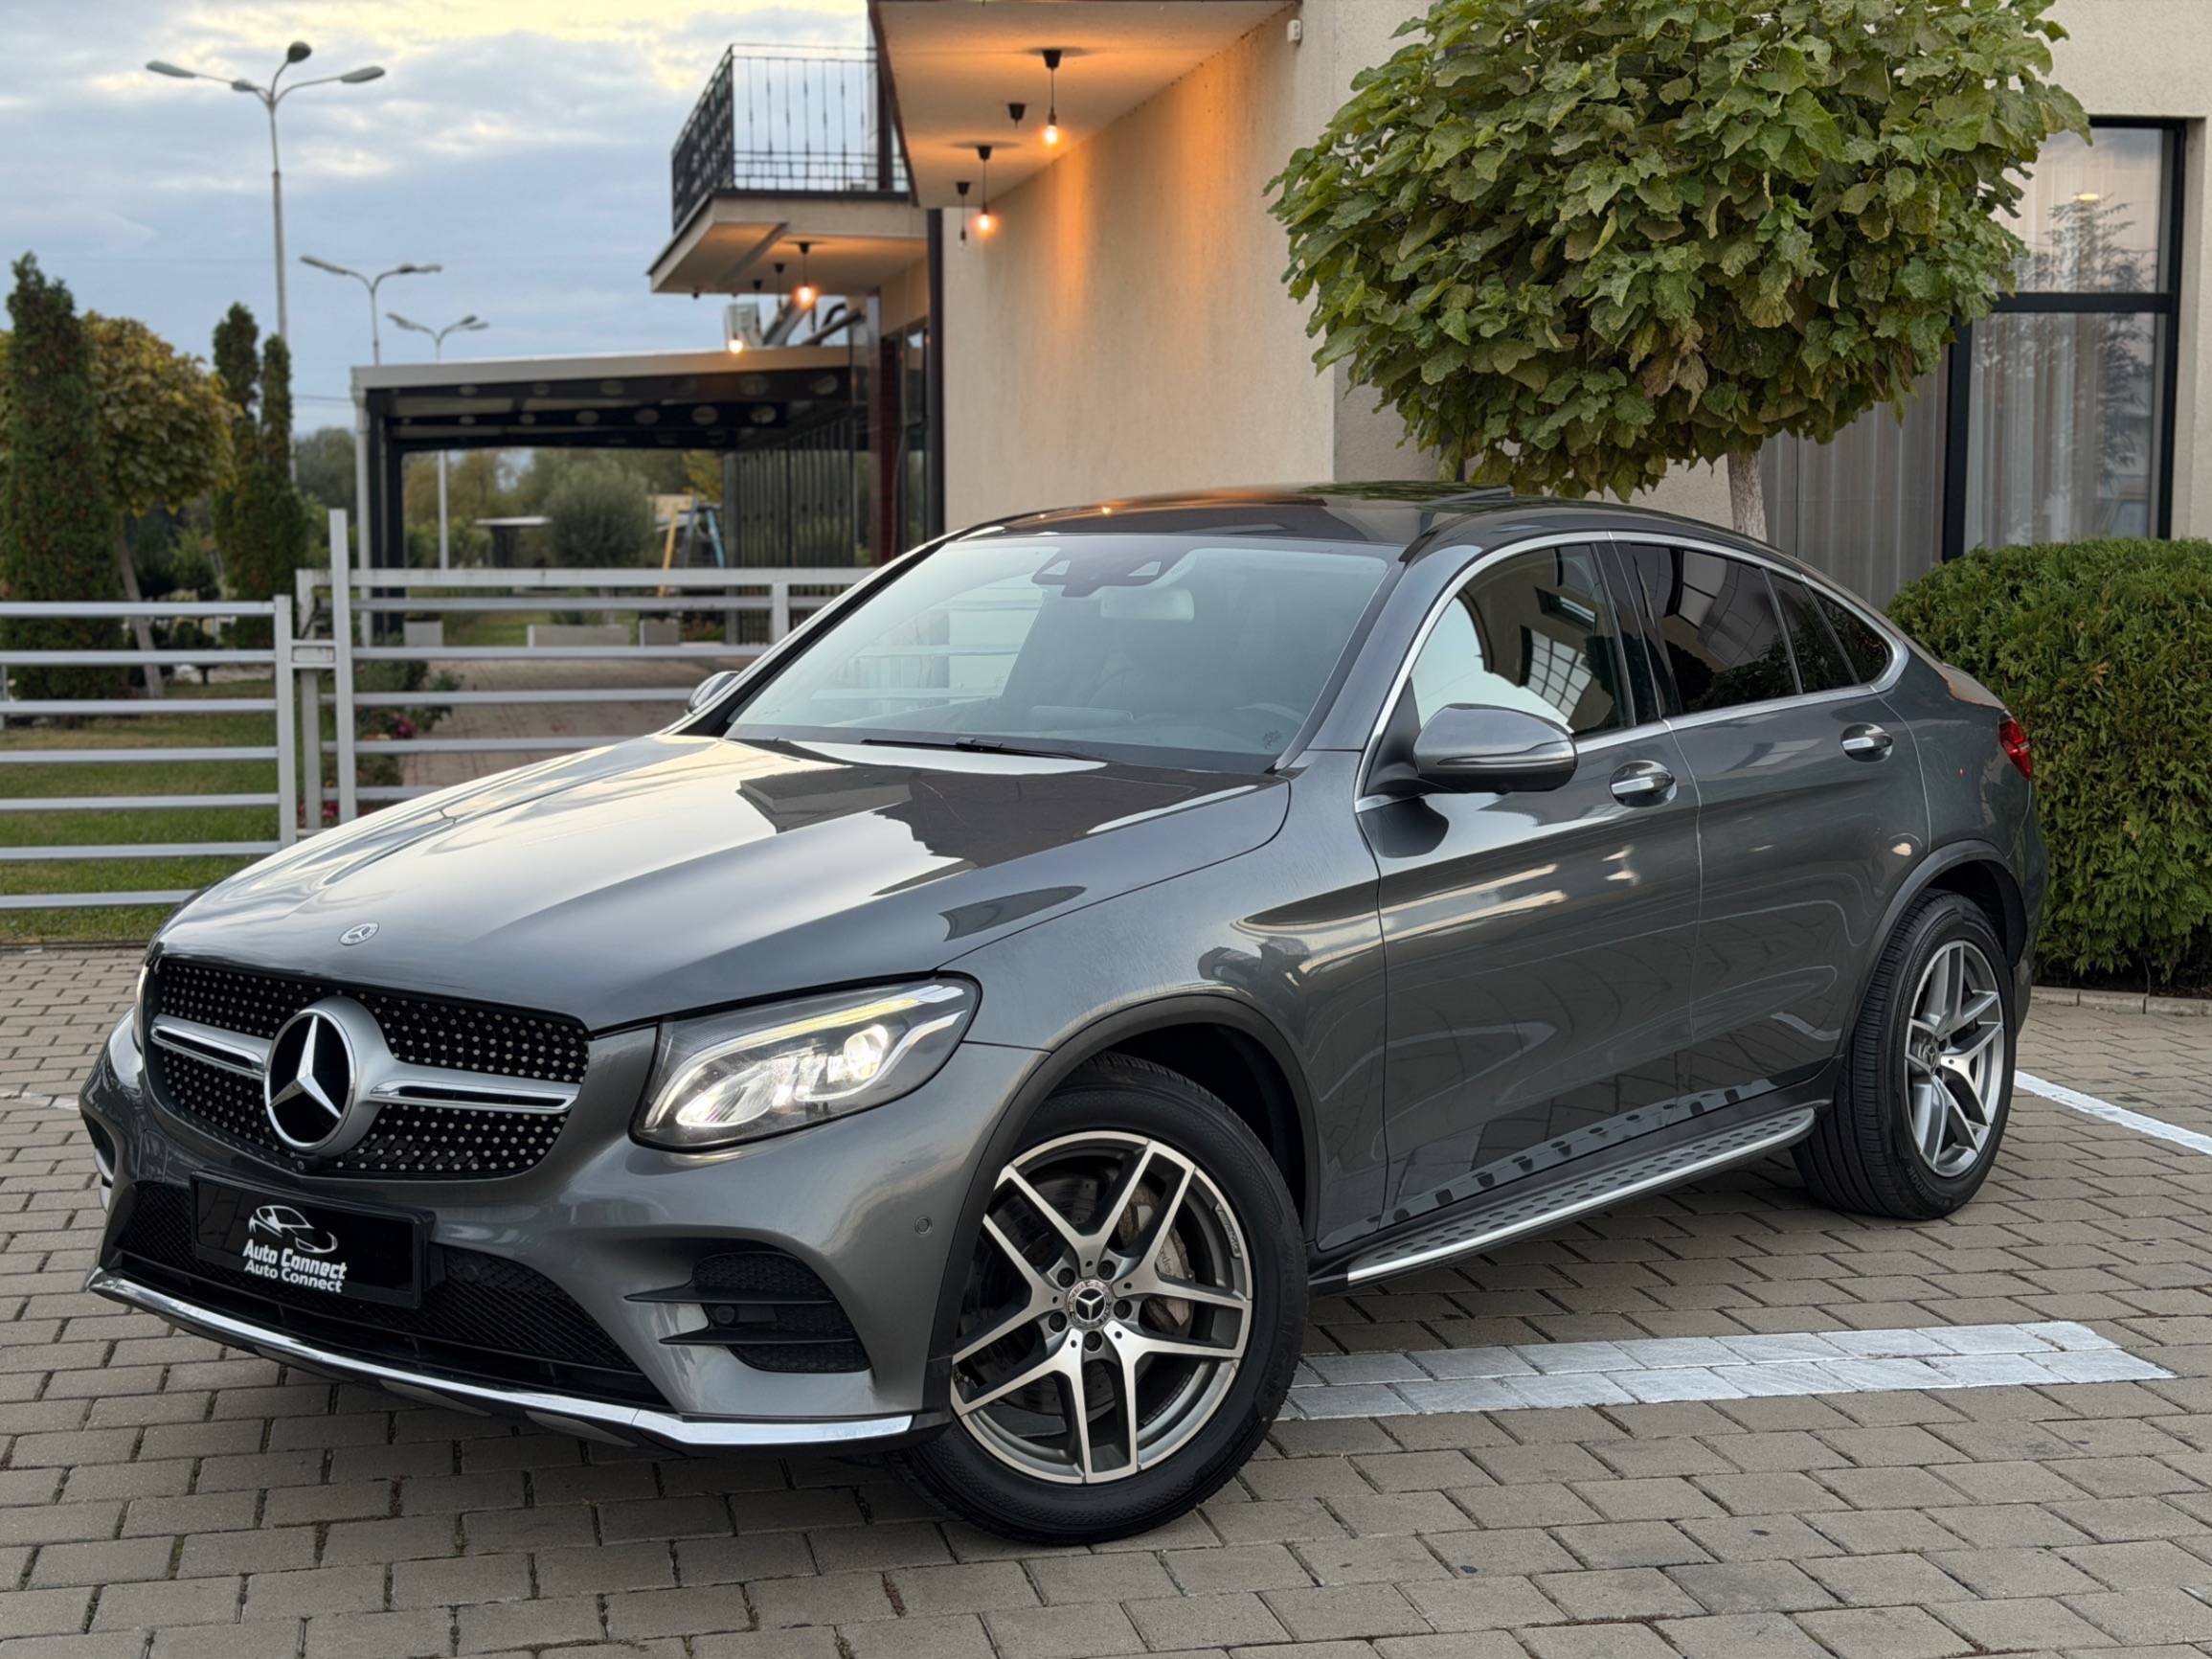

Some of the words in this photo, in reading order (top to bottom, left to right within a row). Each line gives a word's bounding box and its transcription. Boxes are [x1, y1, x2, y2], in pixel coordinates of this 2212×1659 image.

[242, 1239, 279, 1264] Auto
[281, 1248, 348, 1280] Connect
[244, 1260, 279, 1279] Auto
[281, 1268, 343, 1293] Connect
